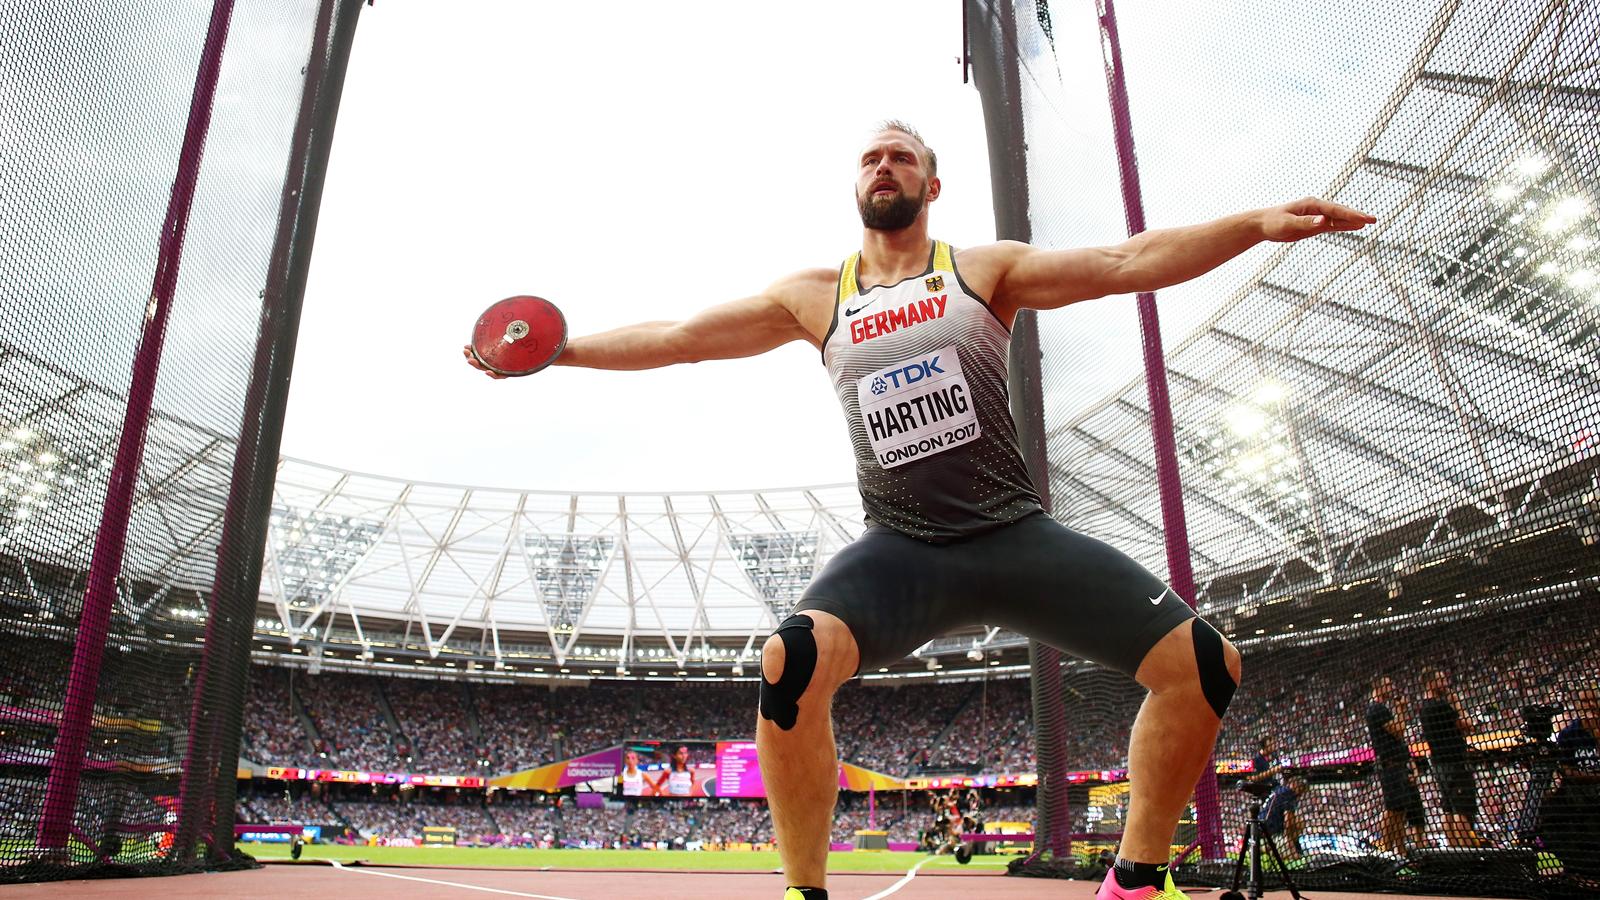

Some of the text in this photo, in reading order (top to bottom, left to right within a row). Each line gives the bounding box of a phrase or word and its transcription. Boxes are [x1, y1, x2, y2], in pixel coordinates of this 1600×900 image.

[850, 295, 947, 344] GERMANY
[884, 355, 945, 389] TDK
[867, 383, 969, 442] HARTING
[879, 422, 976, 466] LONDON 2017
